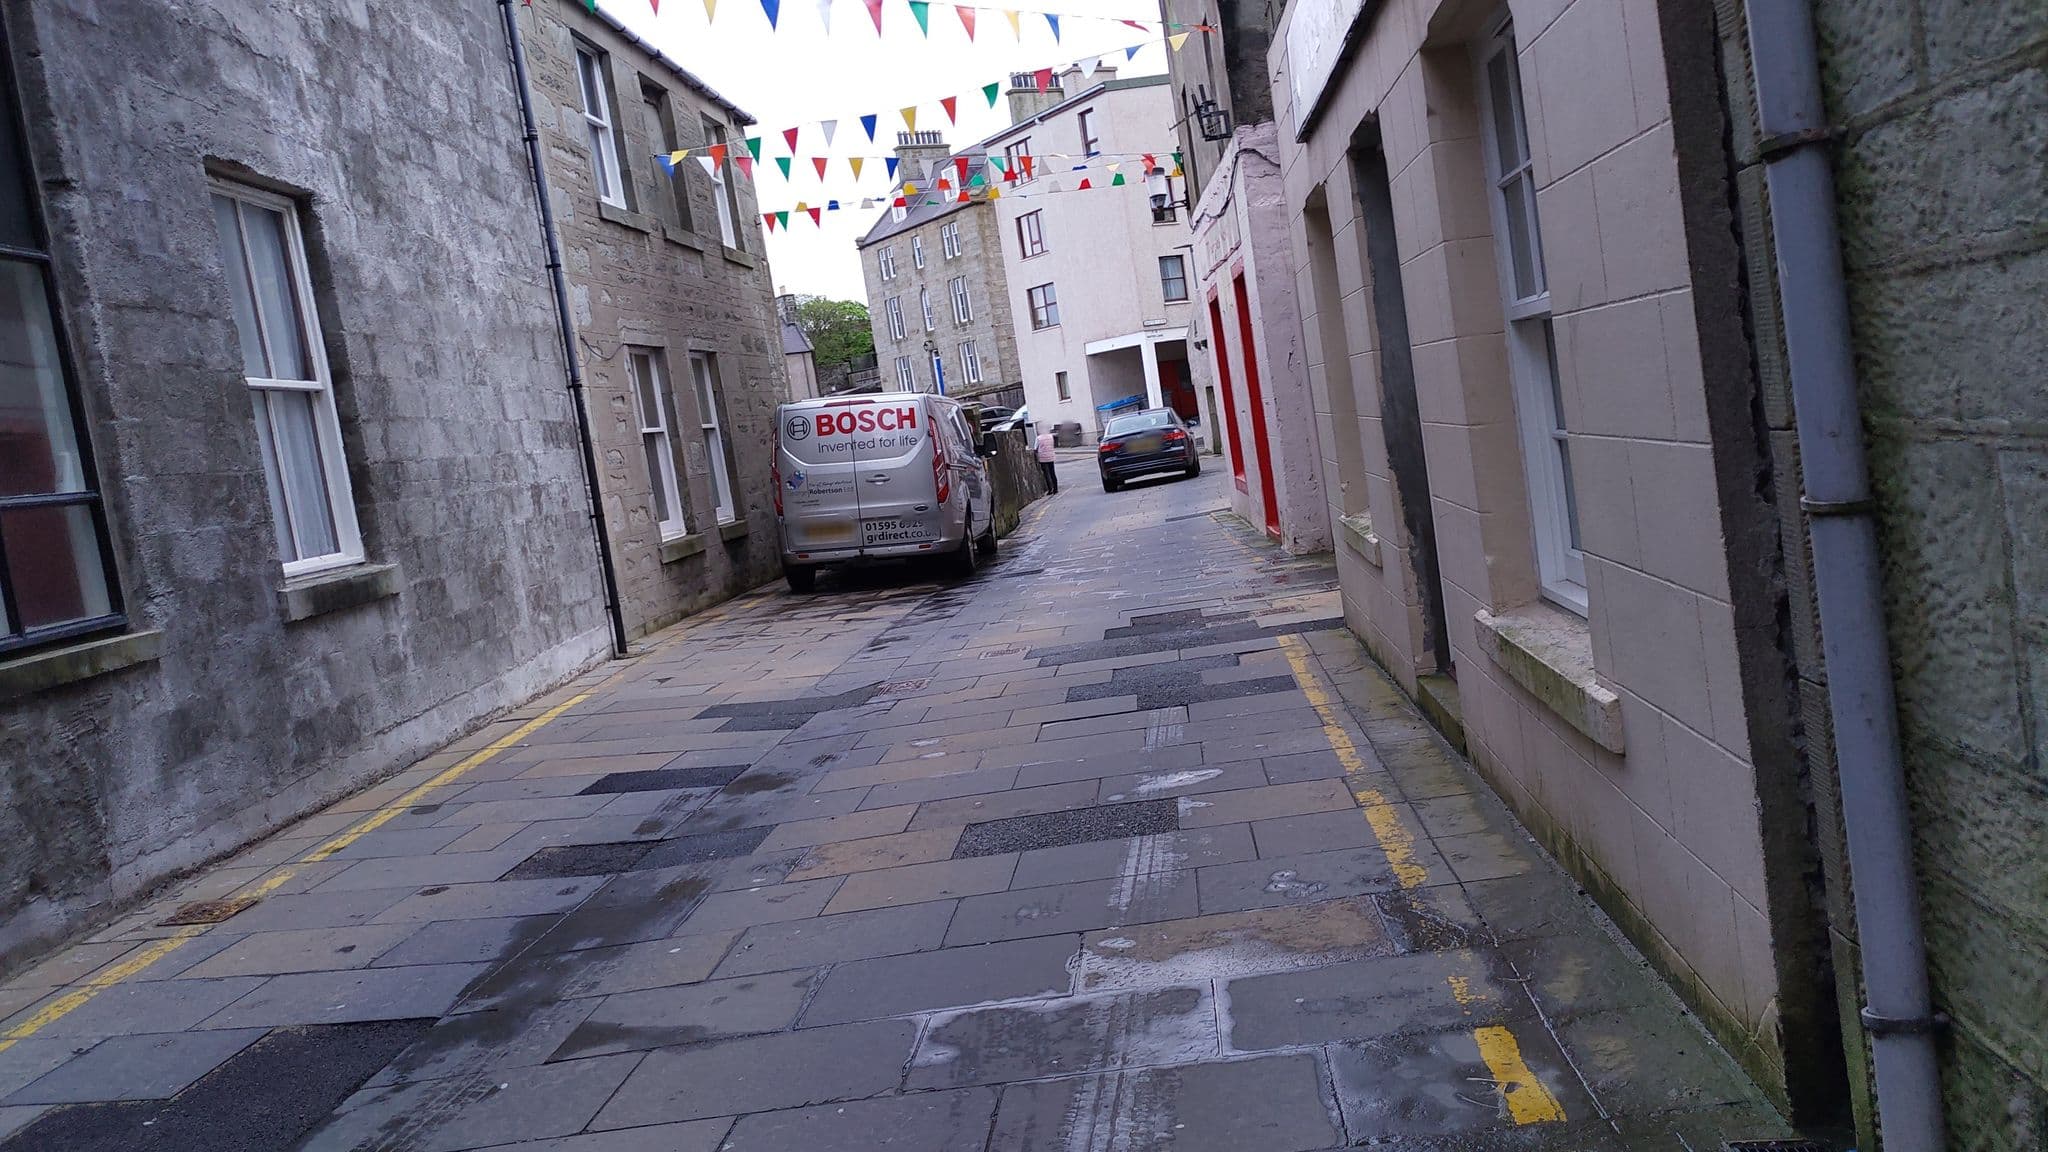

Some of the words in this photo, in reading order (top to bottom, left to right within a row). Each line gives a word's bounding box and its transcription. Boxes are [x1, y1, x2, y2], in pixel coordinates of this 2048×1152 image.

[815, 407, 917, 437] BOSCH
[818, 437, 876, 453] Invented
[879, 437, 895, 448] for
[900, 435, 918, 446] life
[865, 521, 897, 531] 01595
